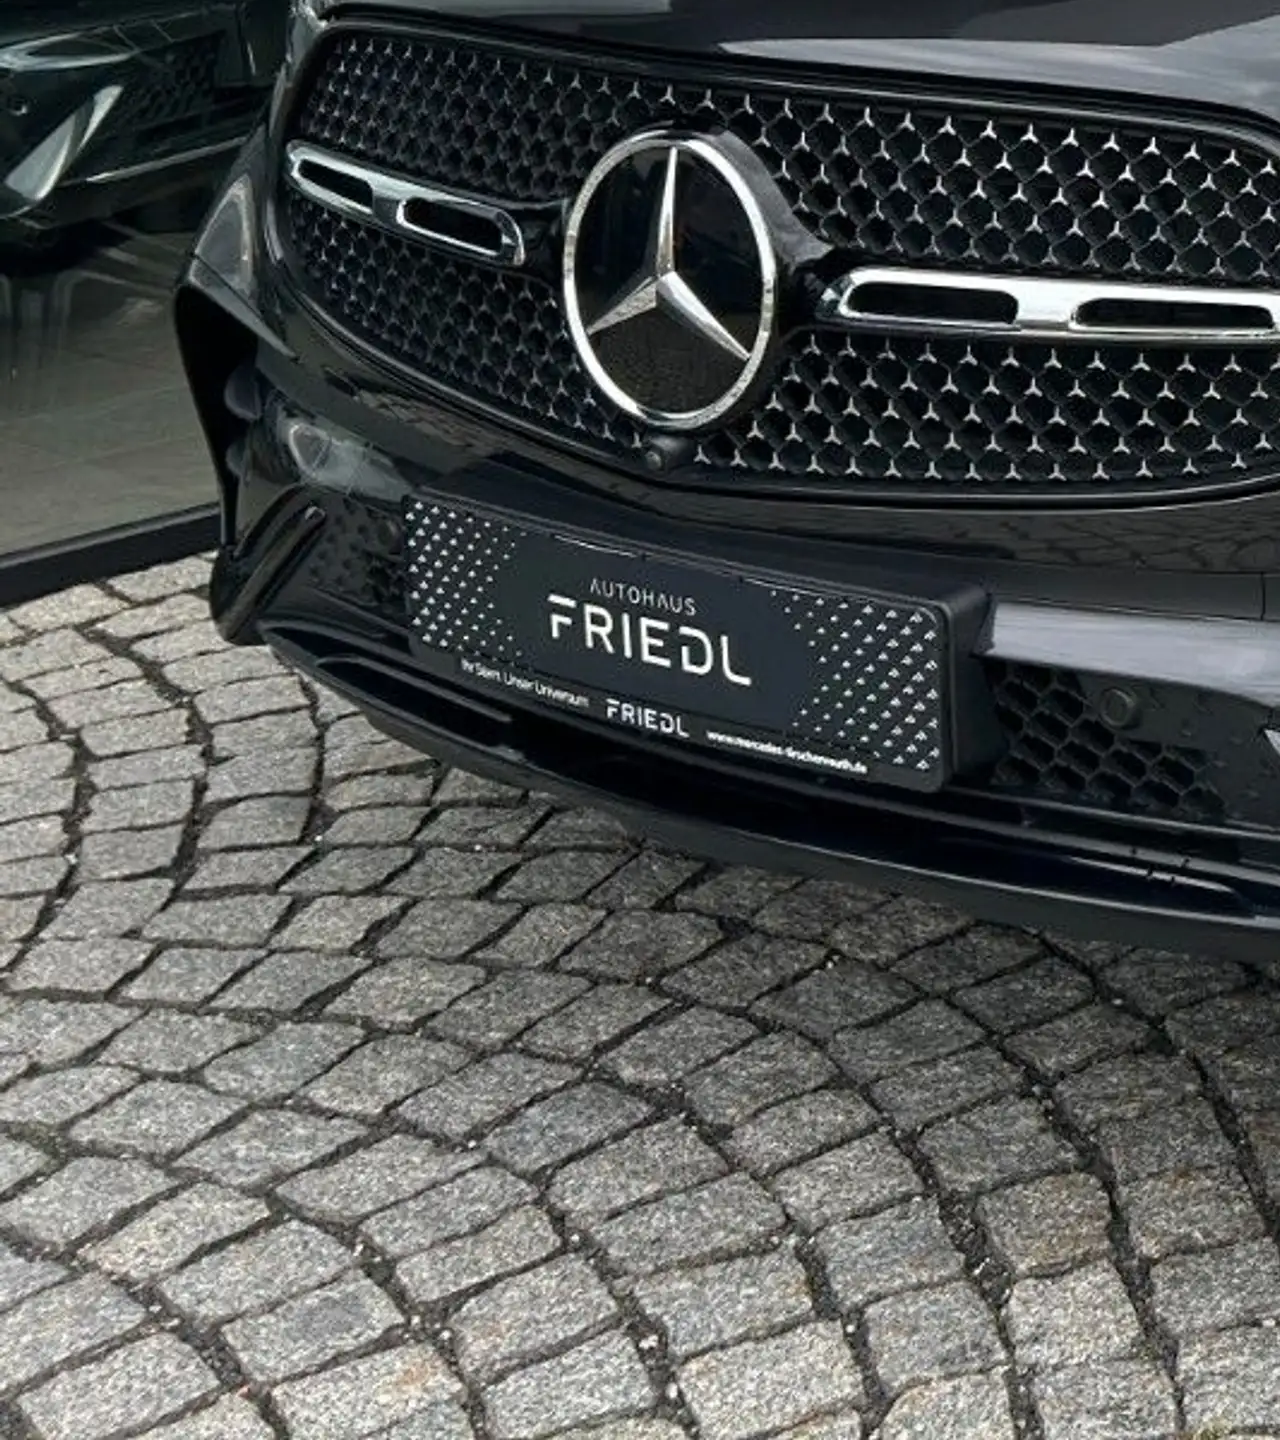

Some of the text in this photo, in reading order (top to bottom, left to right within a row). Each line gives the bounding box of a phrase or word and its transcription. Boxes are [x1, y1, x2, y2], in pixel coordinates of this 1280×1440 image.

[589, 577, 697, 616] AUTOHAUS
[547, 593, 752, 687] FRIEDL
[605, 697, 690, 738] FRIEDL
